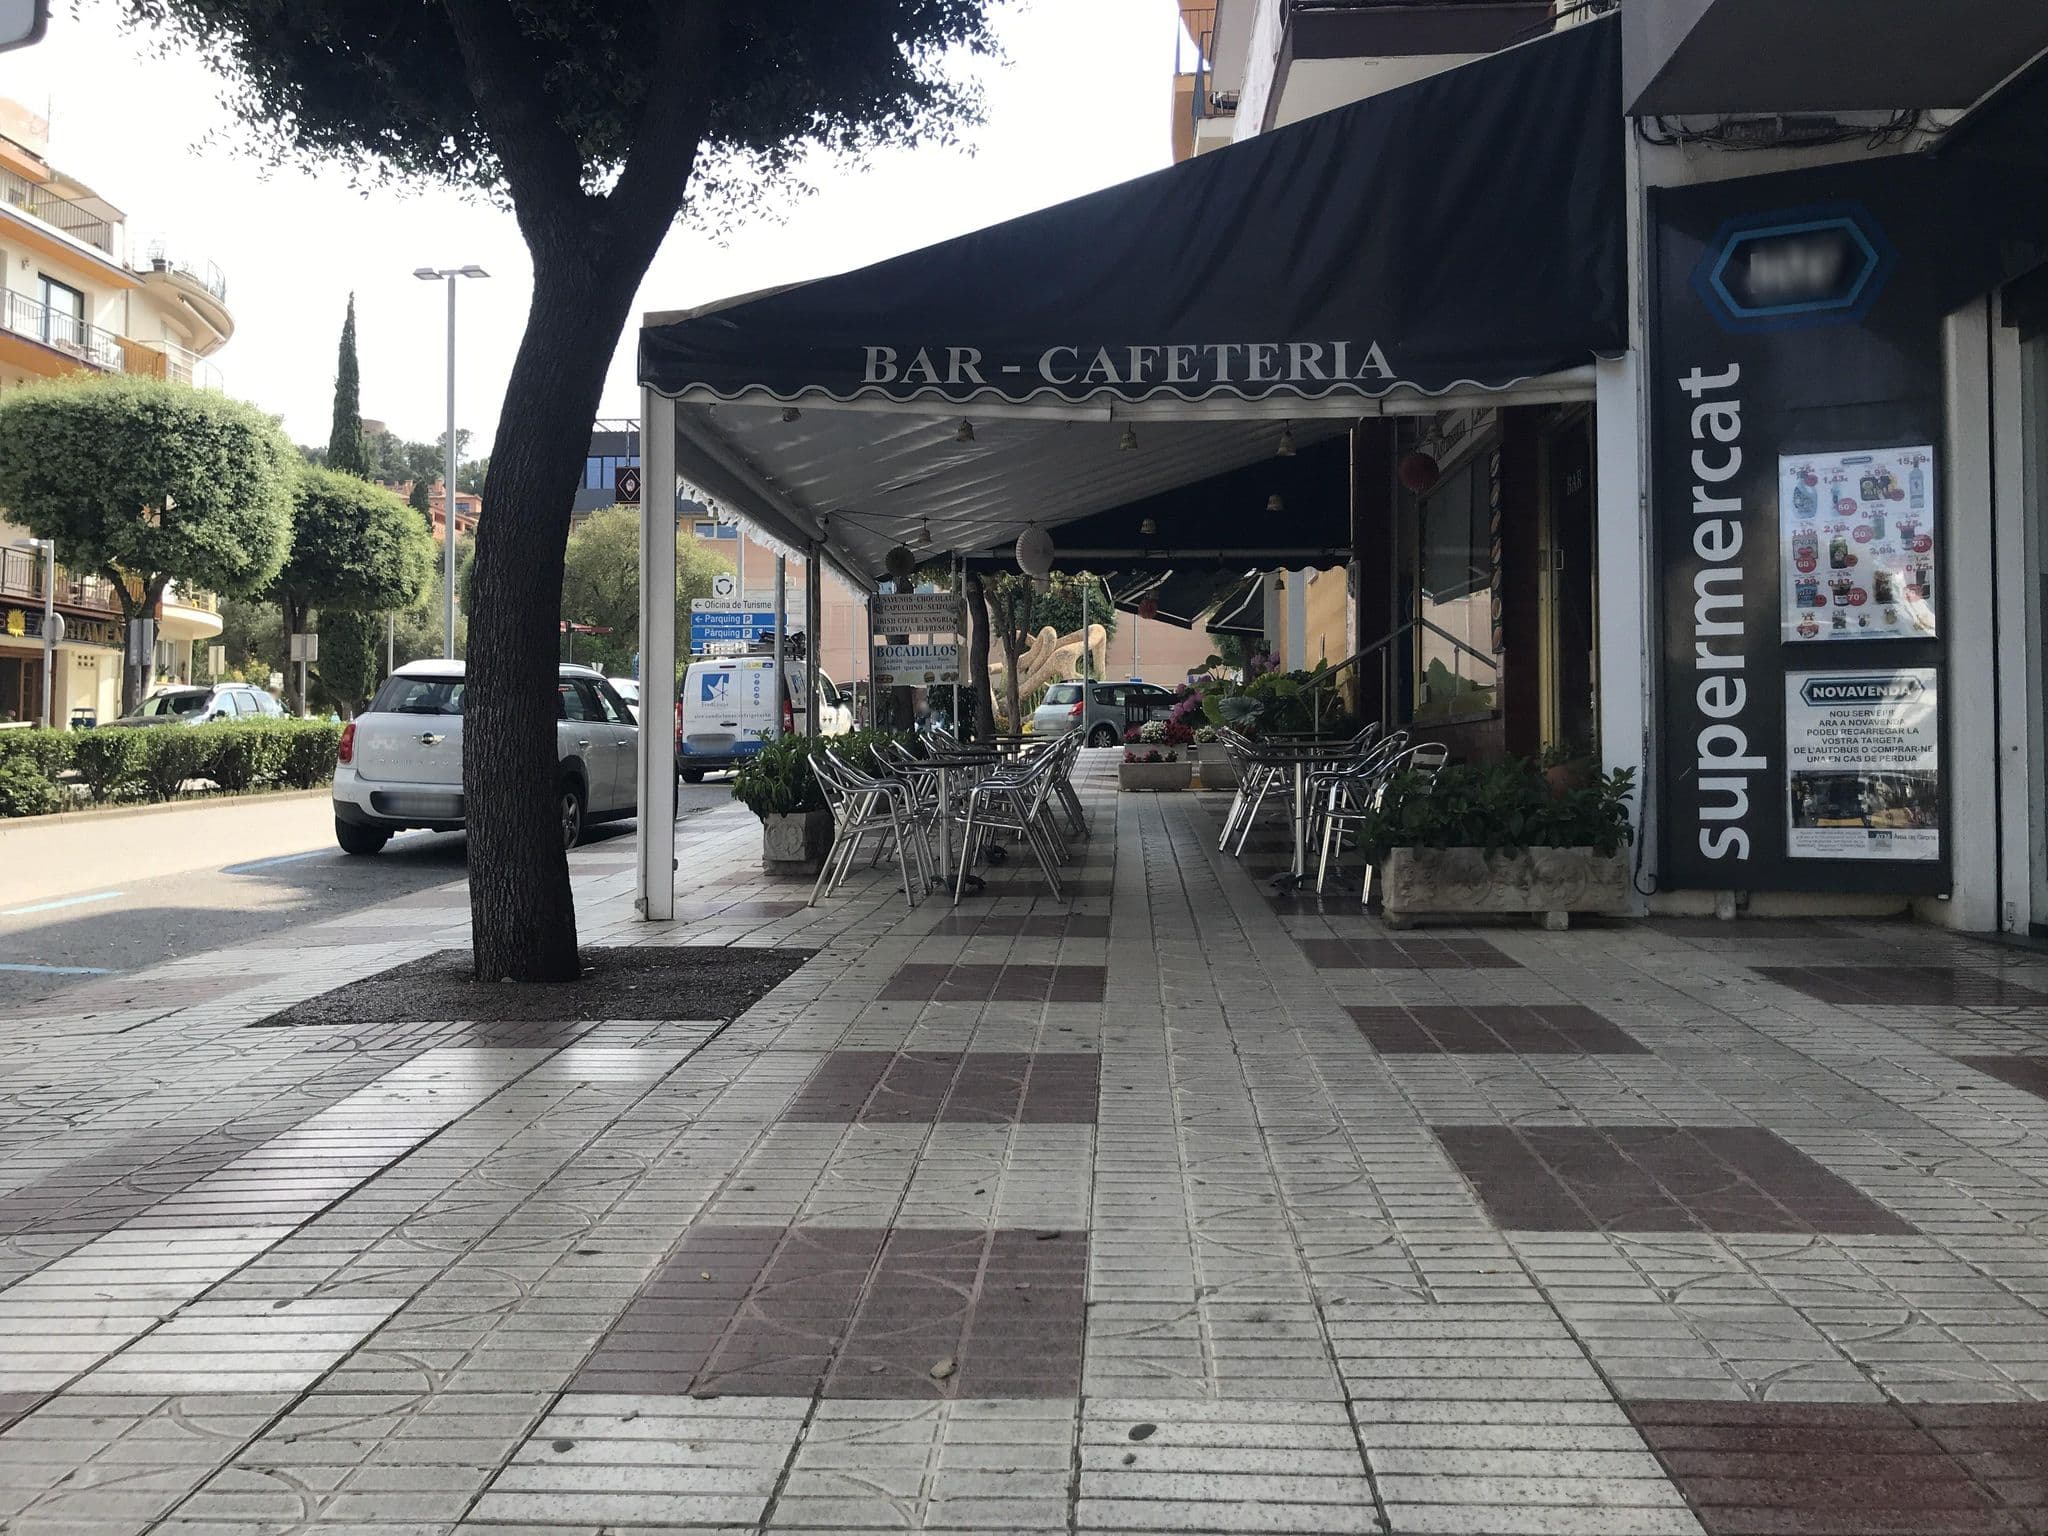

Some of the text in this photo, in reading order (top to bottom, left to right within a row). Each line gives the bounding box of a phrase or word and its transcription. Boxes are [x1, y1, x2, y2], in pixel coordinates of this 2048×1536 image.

[861, 346, 988, 384] BAR
[1037, 339, 1397, 385] CAFETERIA
[704, 600, 772, 609] Oficina de Turisme
[1678, 363, 1767, 861] supermercat
[876, 645, 957, 657] BOCADILLOS
[1813, 685, 1912, 698] NOVAVENDA
[1829, 709, 1850, 718] NOU
[1819, 719, 1838, 727] ARA
[1839, 719, 1847, 727] A
[1807, 727, 1920, 737] PODEU RECARREGAR LA
[1821, 736, 1904, 745] VOSTRA TARGETA
[1871, 745, 1934, 753] COMPRAR-NE
[1807, 755, 1826, 763] UNA
[1843, 754, 1862, 763] CAS
[1864, 754, 1878, 763] DE
